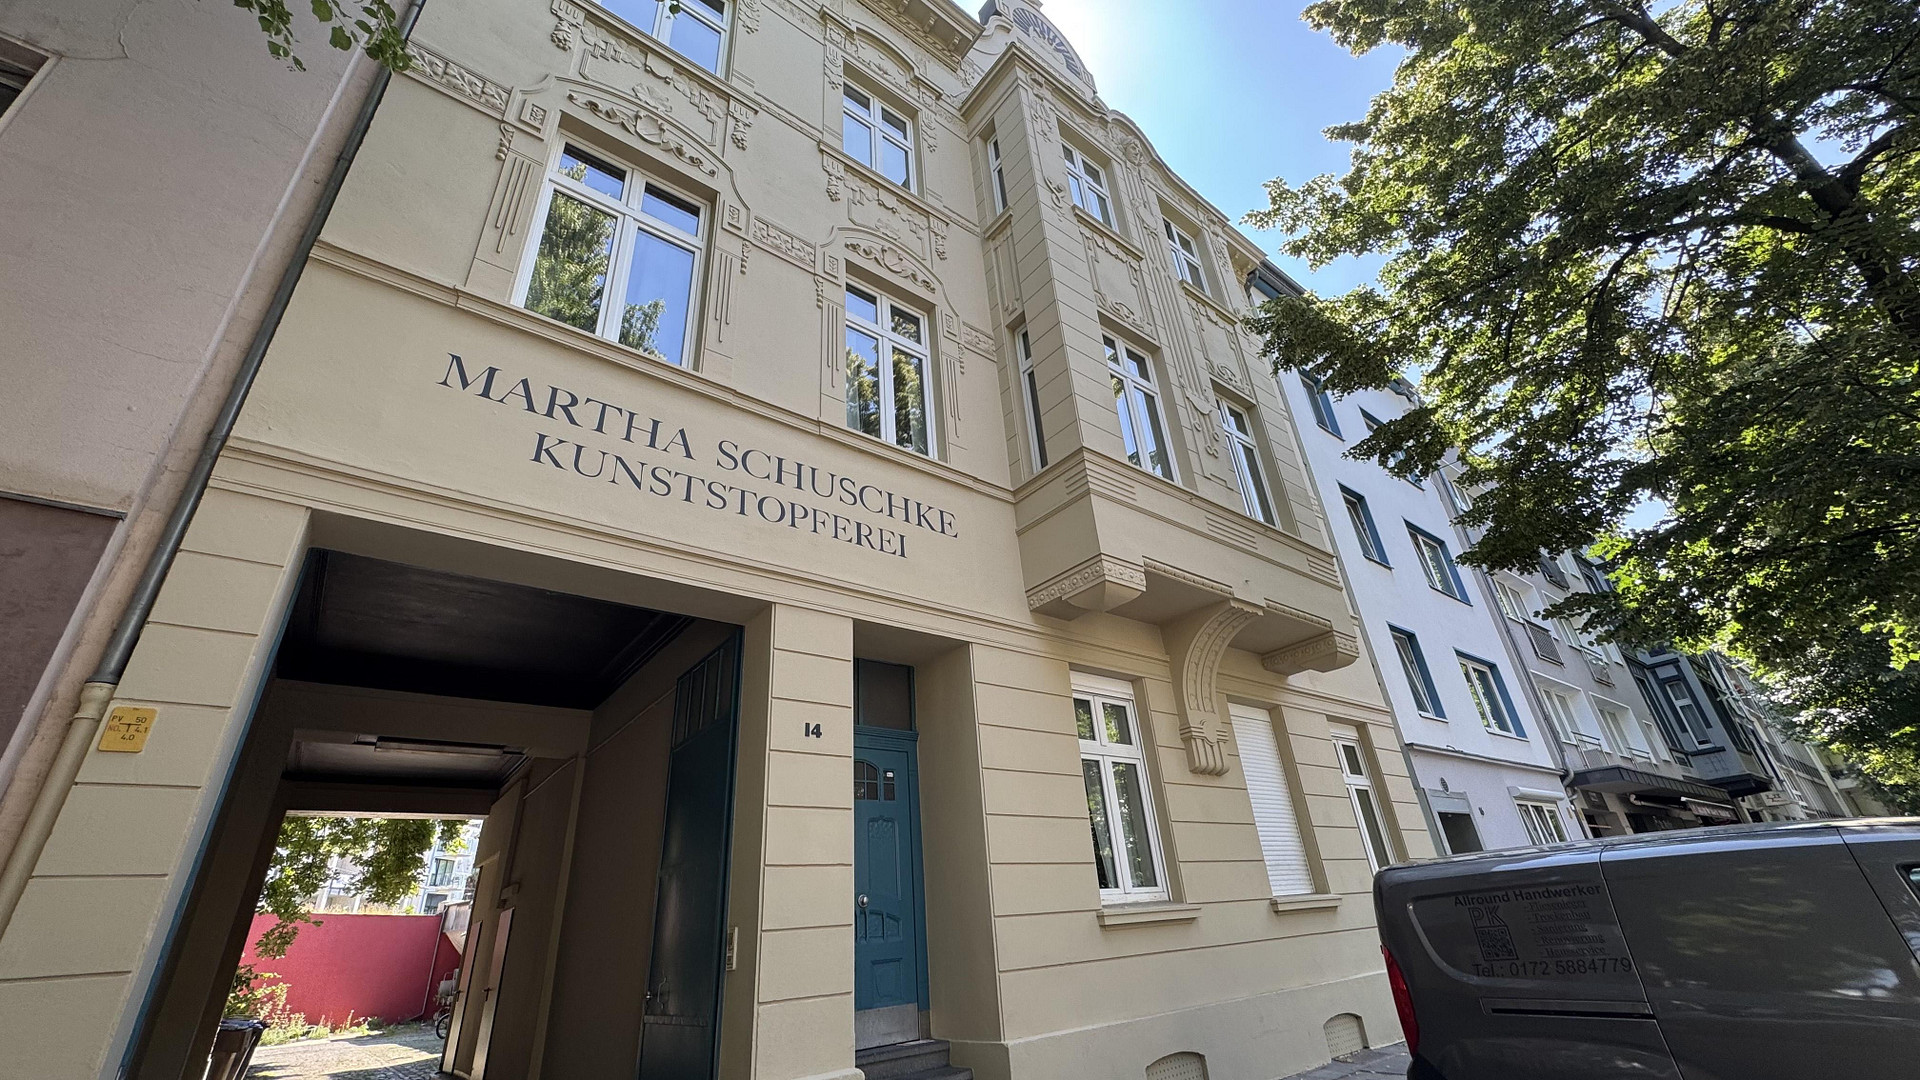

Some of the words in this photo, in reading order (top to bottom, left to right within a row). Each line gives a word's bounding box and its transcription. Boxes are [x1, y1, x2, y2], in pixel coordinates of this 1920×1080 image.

[436, 352, 696, 460] MARTHA
[716, 440, 959, 538] SCHUSCHKE
[530, 432, 908, 558] KUNSTSTOPFEREI
[135, 716, 147, 724] 50
[120, 733, 135, 741] 4.0
[804, 722, 822, 738] 14
[1454, 892, 1510, 907] Allround
[1513, 884, 1601, 902] Handwerker
[1509, 961, 1550, 976] 0172
[1555, 957, 1633, 975] 5884779
